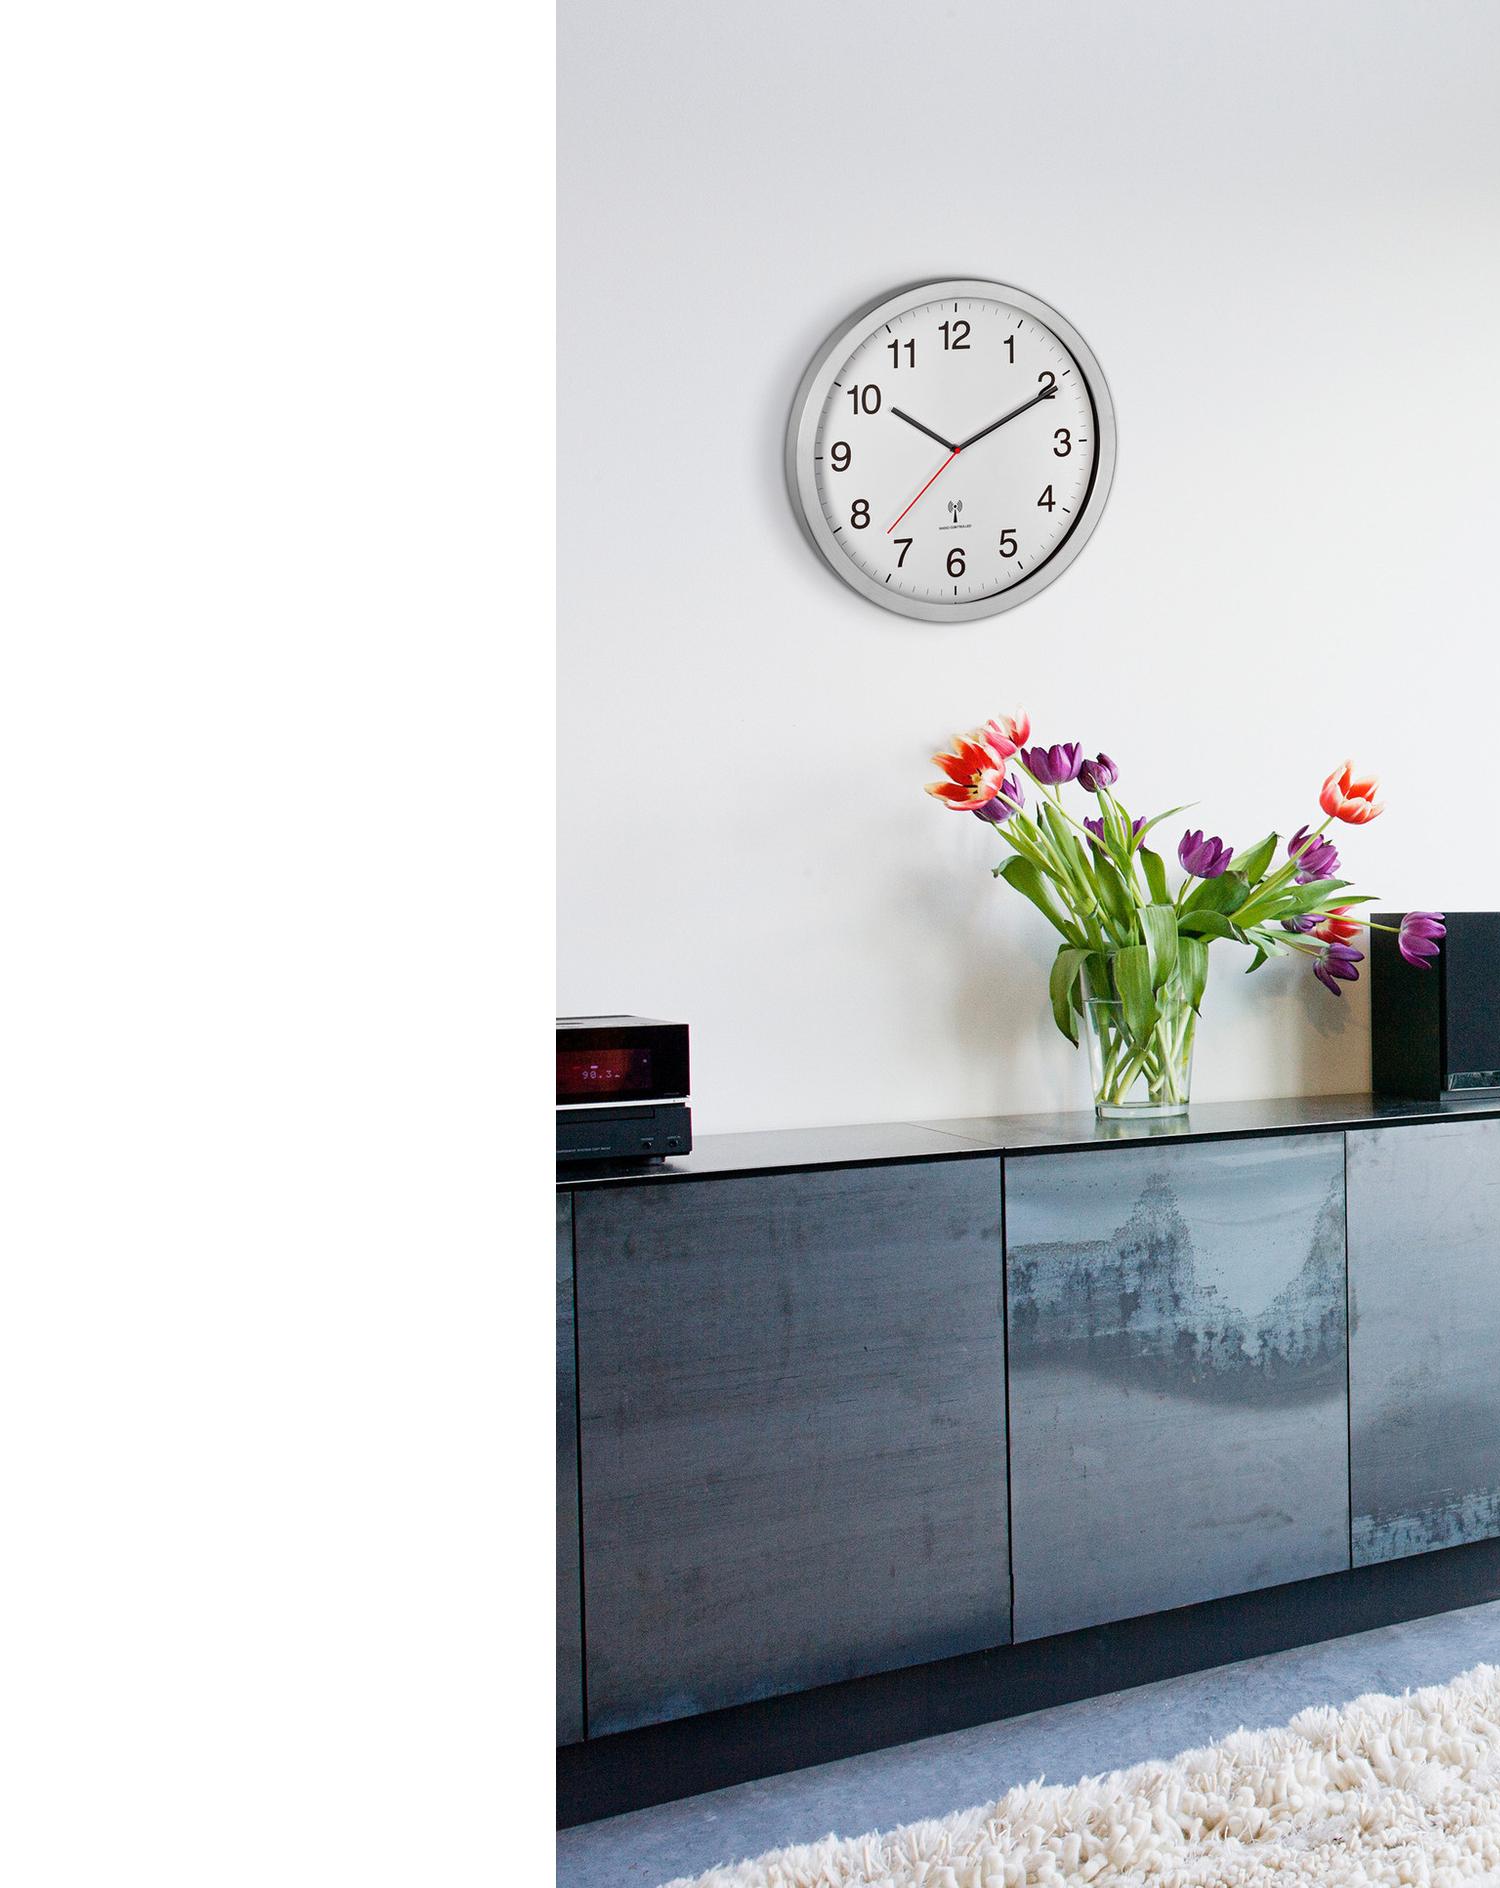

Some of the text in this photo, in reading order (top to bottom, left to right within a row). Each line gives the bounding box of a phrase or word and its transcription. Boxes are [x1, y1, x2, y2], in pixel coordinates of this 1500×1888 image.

[939, 320, 971, 351] 12
[1004, 334, 1014, 364] 1
[888, 338, 915, 369] 11
[846, 384, 882, 415] 10
[1037, 371, 1056, 400] 2
[831, 441, 852, 473] 9
[1053, 428, 1072, 458] 3
[850, 498, 871, 530] 8
[1037, 484, 1056, 513] 4
[893, 537, 913, 568] 7
[999, 528, 1018, 558] 5
[946, 547, 966, 578] 6
